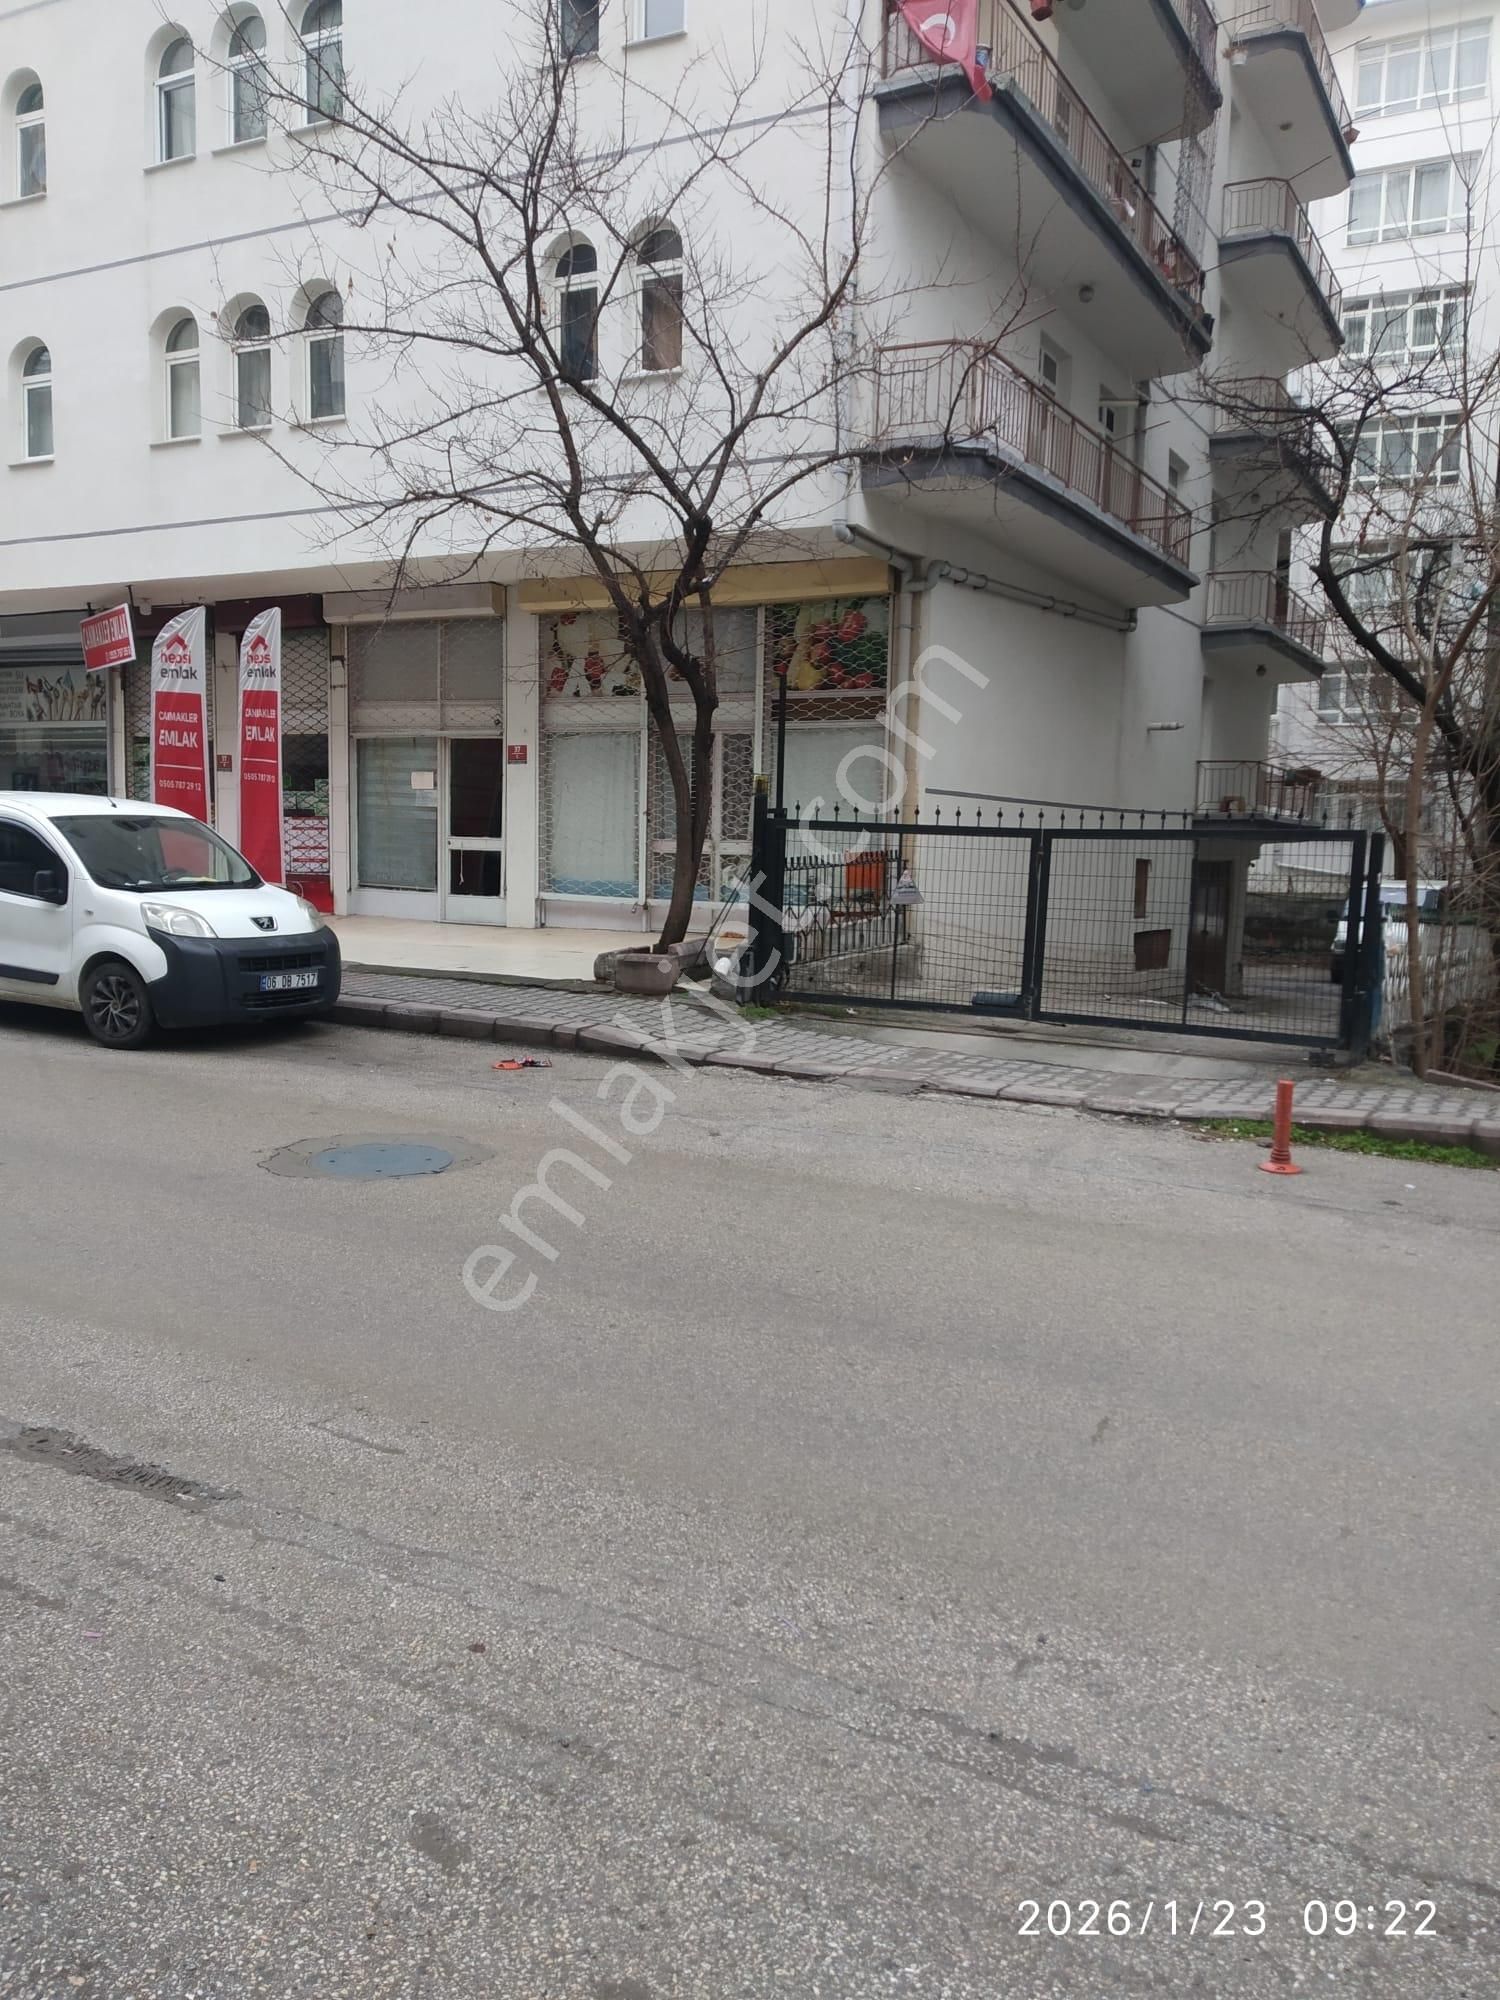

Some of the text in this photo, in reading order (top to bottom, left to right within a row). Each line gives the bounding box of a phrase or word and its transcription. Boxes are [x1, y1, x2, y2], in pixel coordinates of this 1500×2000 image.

[160, 650, 192, 666] hepsi
[160, 666, 198, 680] emlak
[158, 729, 198, 748] EMLAK
[266, 976, 277, 989] 06
[295, 973, 316, 987] 7517
